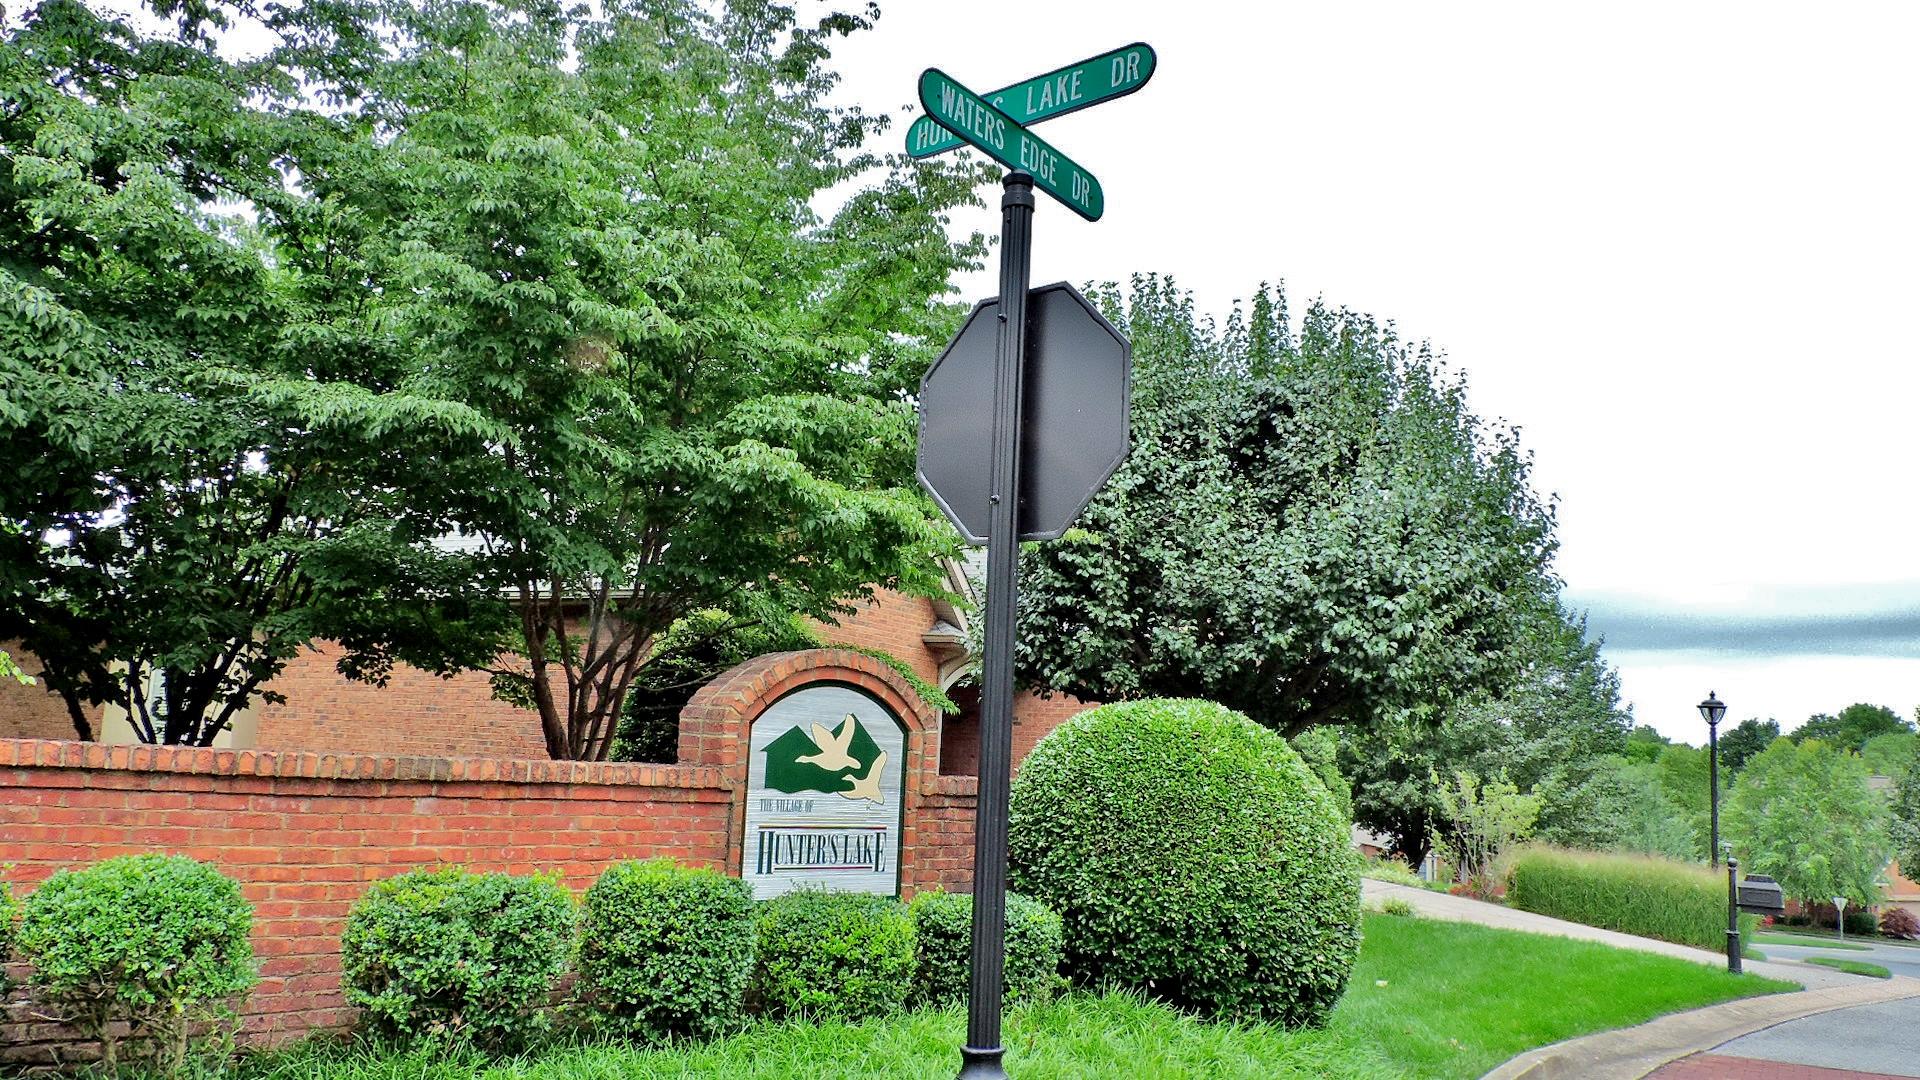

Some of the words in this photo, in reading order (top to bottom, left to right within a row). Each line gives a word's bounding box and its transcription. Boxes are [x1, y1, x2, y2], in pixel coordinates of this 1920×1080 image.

[1026, 69, 1083, 115] LAKE
[1111, 51, 1140, 88] DR
[941, 82, 1004, 150] WATERS
[1020, 135, 1057, 187] EDGE
[1072, 171, 1089, 208] DR
[760, 799, 773, 812] THE
[776, 799, 801, 813] VILLAGE
[804, 800, 814, 812] OF
[756, 831, 839, 874] HUNTER'S
[842, 832, 887, 872] LAKE
